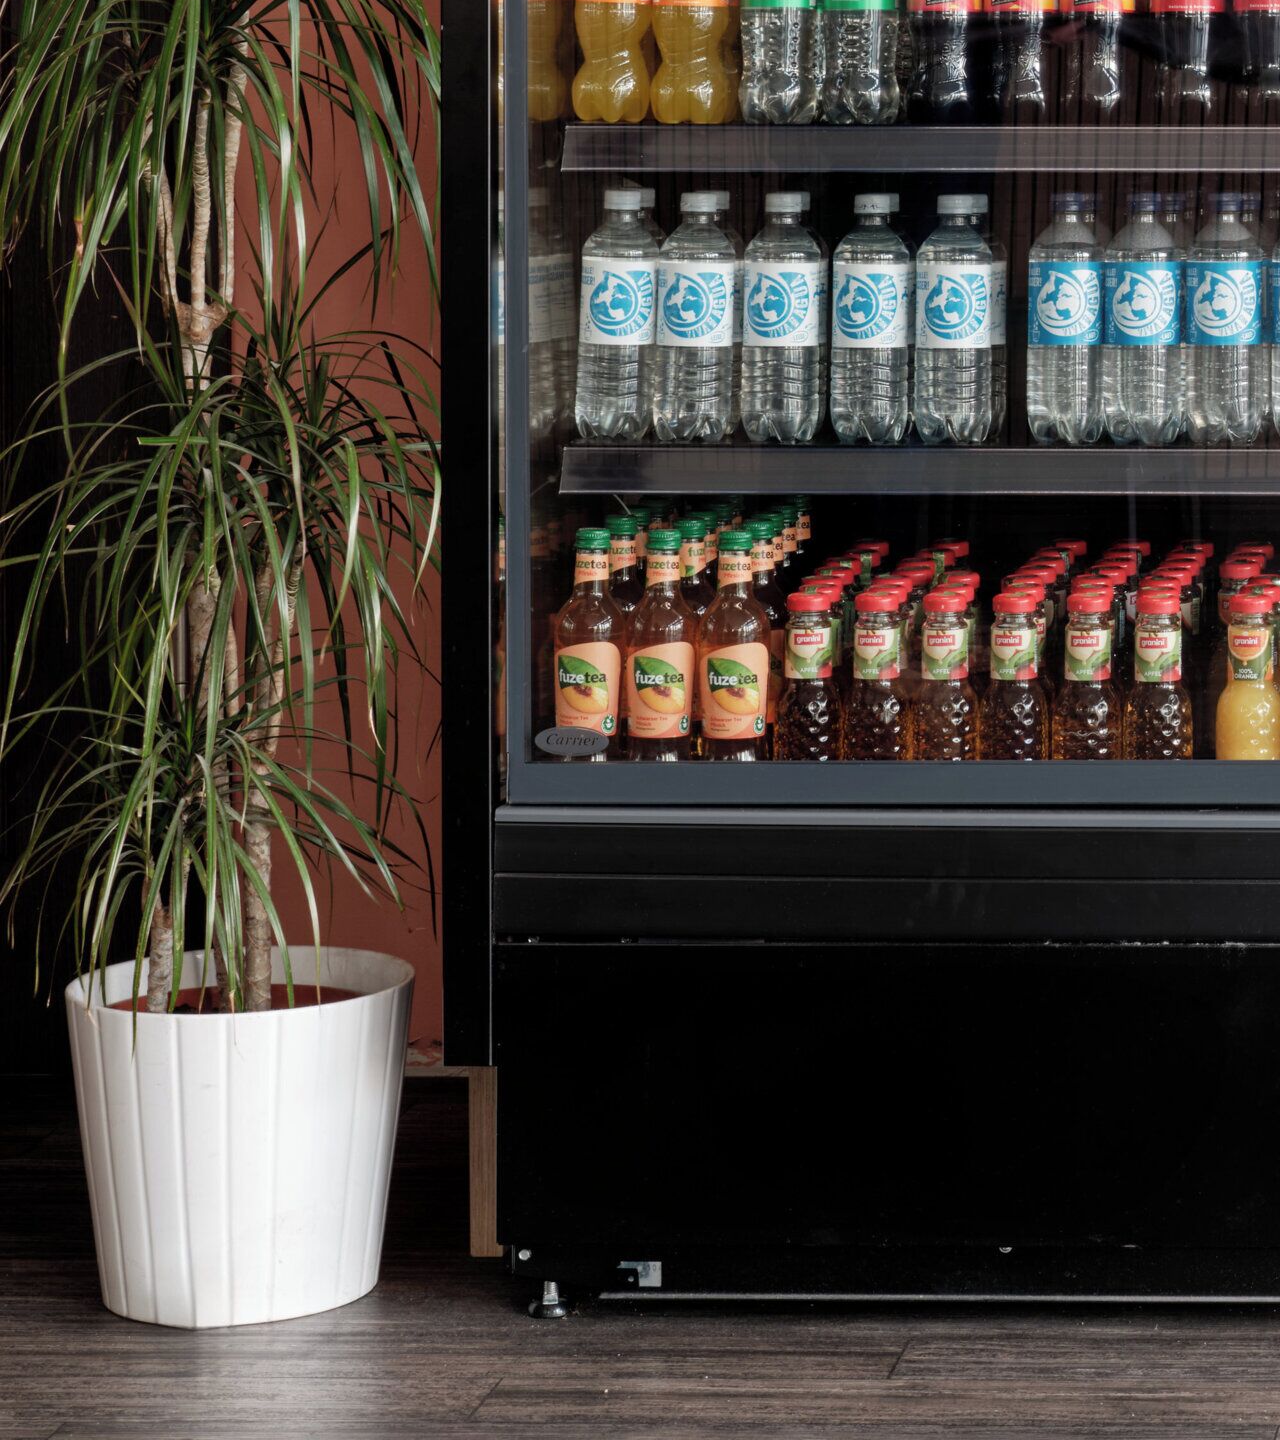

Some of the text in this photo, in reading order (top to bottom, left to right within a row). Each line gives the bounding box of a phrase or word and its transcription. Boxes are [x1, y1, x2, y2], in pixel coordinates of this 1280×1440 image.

[796, 635, 821, 645] granini
[860, 636, 883, 645] granini
[929, 636, 953, 646] granini
[996, 636, 1020, 645] granini
[1072, 637, 1097, 646] granini
[1141, 639, 1165, 648] granini
[1235, 638, 1258, 647] granini
[559, 670, 607, 685] fuzetea
[635, 670, 684, 685] fuzetea
[708, 671, 758, 686] fuzetea
[546, 733, 600, 747] Carrier
